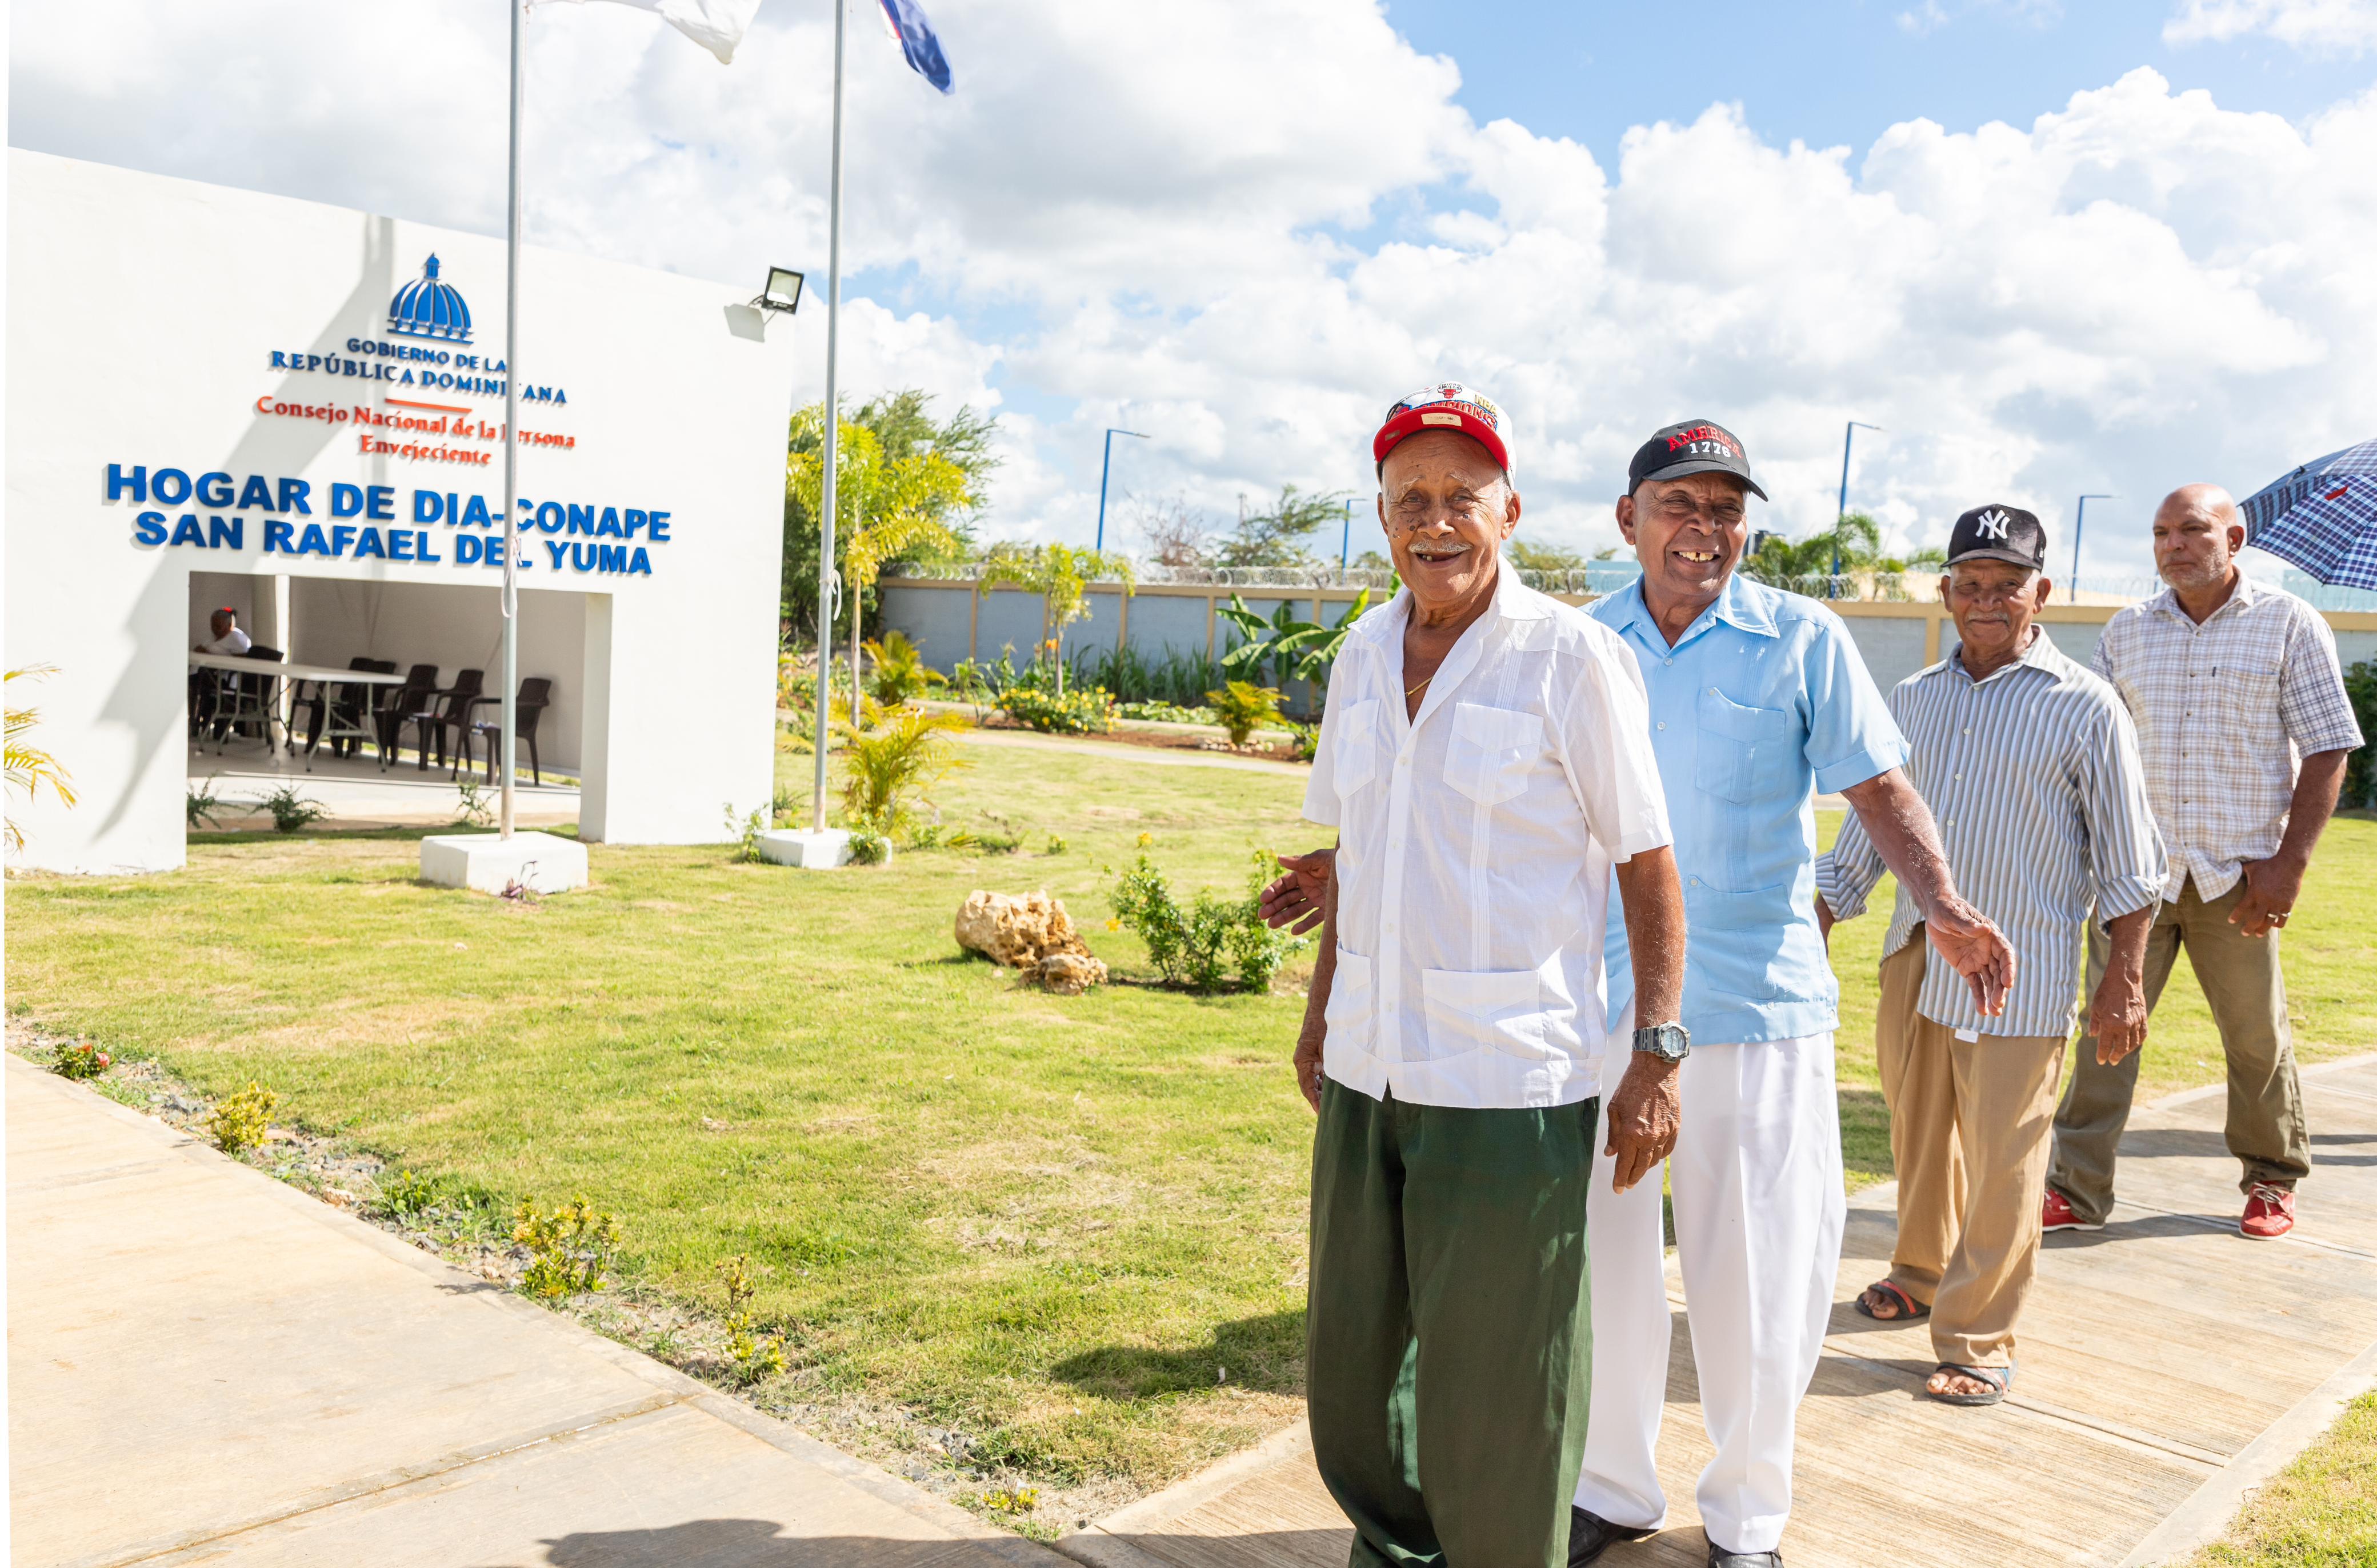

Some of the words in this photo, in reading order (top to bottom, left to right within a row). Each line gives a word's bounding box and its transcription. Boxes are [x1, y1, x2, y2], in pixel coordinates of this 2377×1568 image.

[346, 338, 450, 365] GOBIERNO
[457, 354, 479, 370] DE
[485, 359, 507, 371] LA
[271, 350, 415, 385] REPÚBLICA
[422, 370, 567, 403] DOMINIANA
[257, 395, 349, 425] Consejo
[353, 406, 447, 434] Nacional
[451, 417, 476, 437] de
[479, 420, 496, 439] la
[502, 423, 575, 448] ersona
[1474, 394, 1498, 418] NBA
[361, 434, 492, 466] Envejeciente
[1666, 425, 1742, 459] AMERICA
[1688, 441, 1731, 458] 1776
[107, 463, 313, 515] HOGAR
[331, 482, 395, 520] DE
[1975, 509, 2011, 539] NY
[135, 511, 243, 550] SAN
[264, 519, 442, 562] RAFAEL
[545, 539, 653, 575] YUMA
